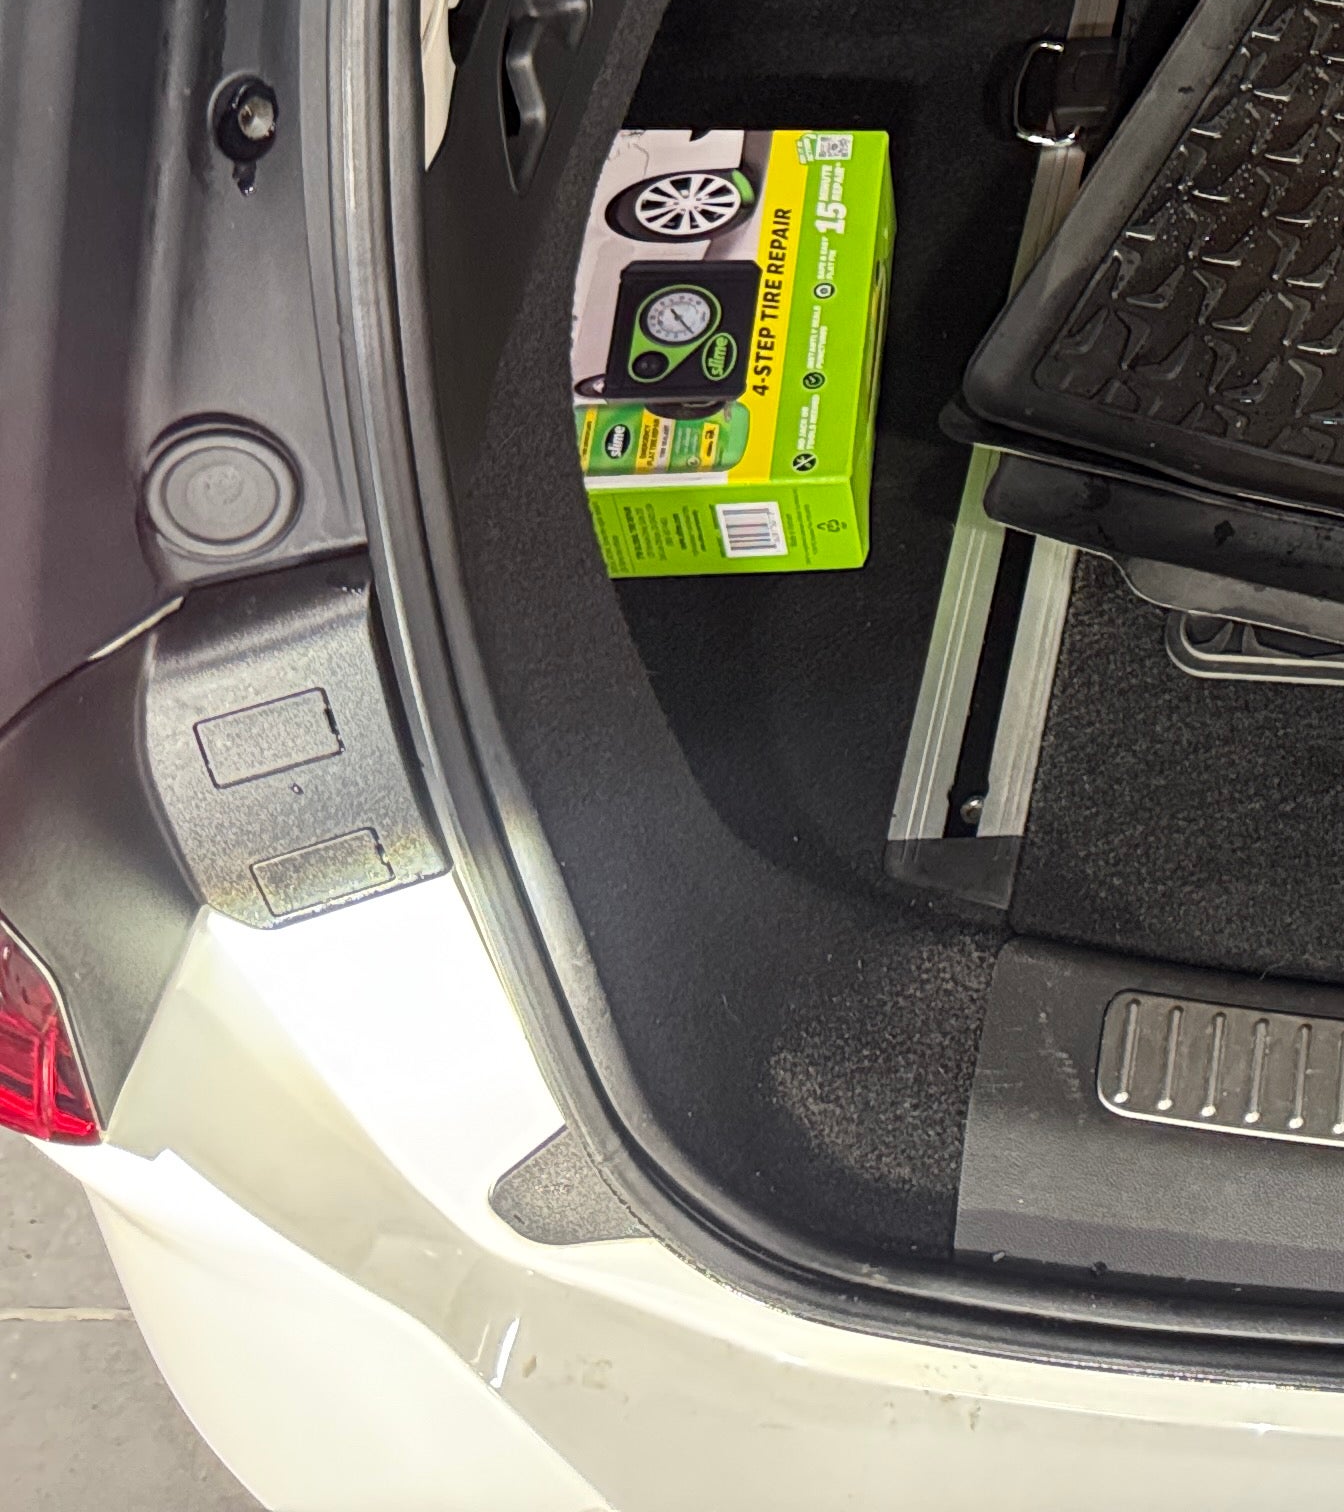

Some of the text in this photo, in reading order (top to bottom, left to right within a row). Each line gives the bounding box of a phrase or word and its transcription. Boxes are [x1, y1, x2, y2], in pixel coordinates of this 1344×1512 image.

[819, 165, 832, 201] MINUTE
[814, 201, 847, 235] 15
[752, 207, 792, 397] 4-STEP TIRE REPAIR
[708, 336, 728, 376] slime
[608, 425, 626, 458] slime
